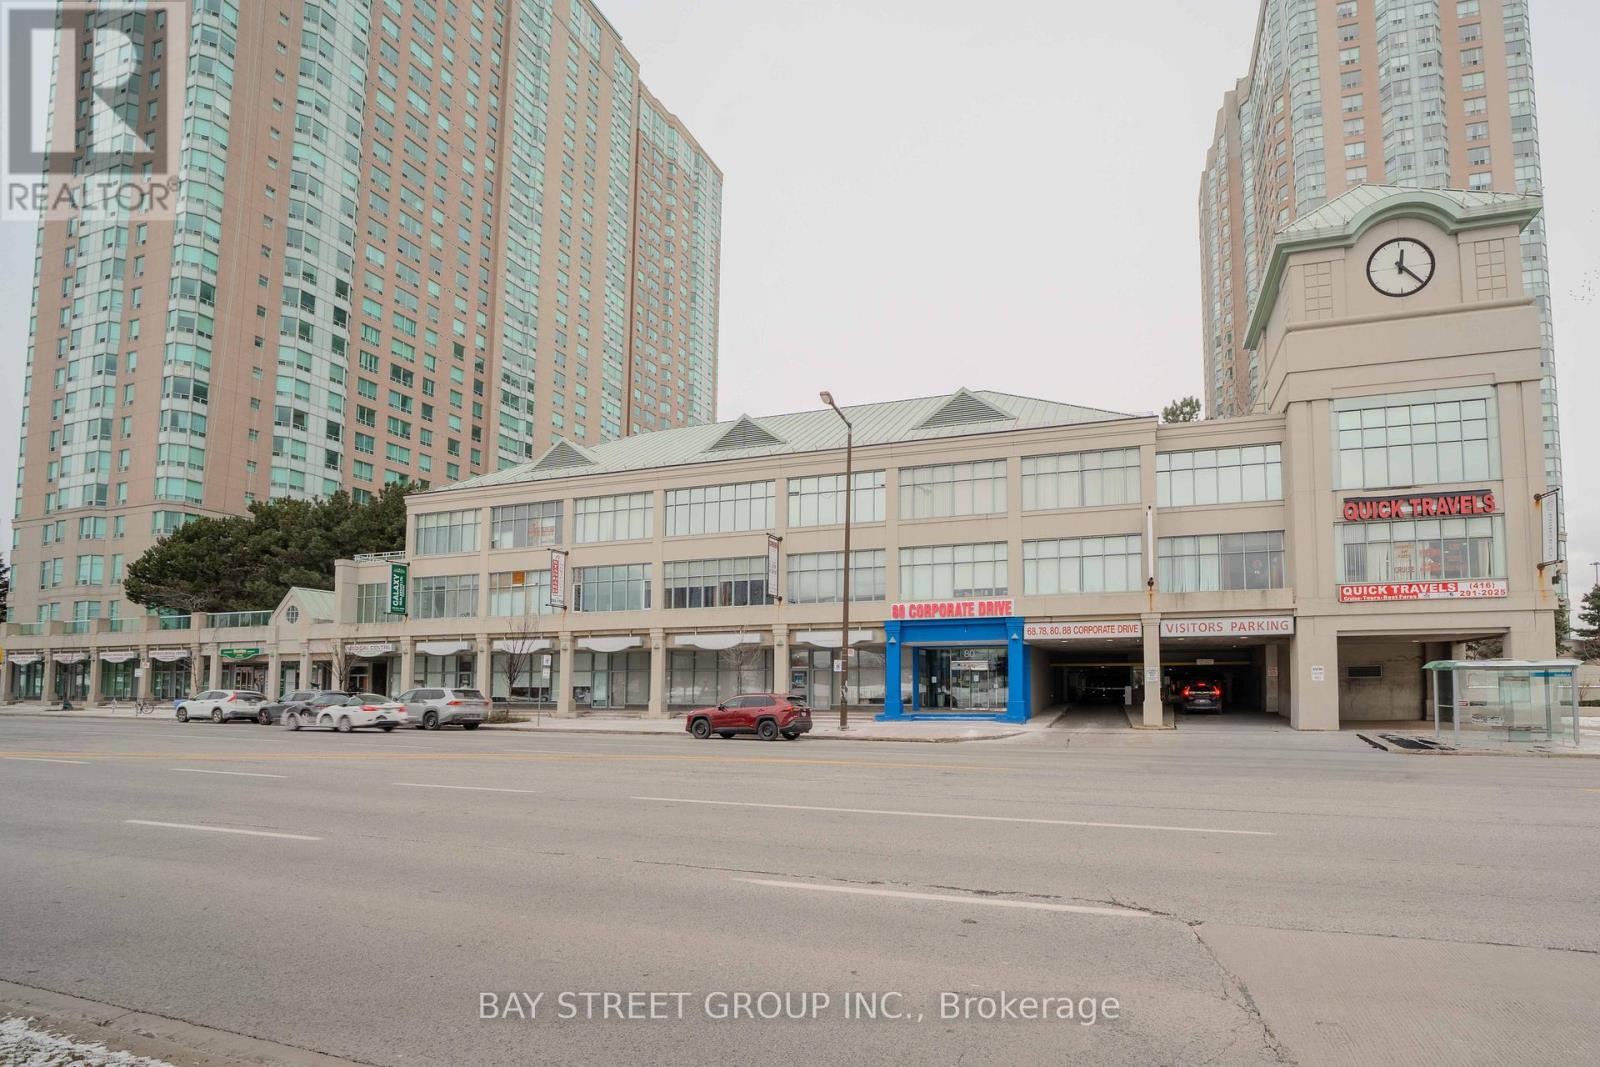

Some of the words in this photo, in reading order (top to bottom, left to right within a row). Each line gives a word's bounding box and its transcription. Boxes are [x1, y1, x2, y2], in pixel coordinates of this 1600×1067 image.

[1343, 499, 1405, 522] QUICK
[1408, 493, 1496, 517] TRAVELS
[1342, 585, 1388, 596] QUICK
[1391, 581, 1457, 595] TRAVELS
[1459, 589, 1506, 597] 291-2025
[891, 604, 906, 619] 80
[908, 601, 975, 619] CORPORATE
[978, 600, 1013, 617] DRIVE
[1073, 624, 1116, 635] CORPORATE
[1117, 624, 1139, 633] DRIVE
[1165, 621, 1224, 634] VISITORS
[1230, 620, 1290, 632] PARKING
